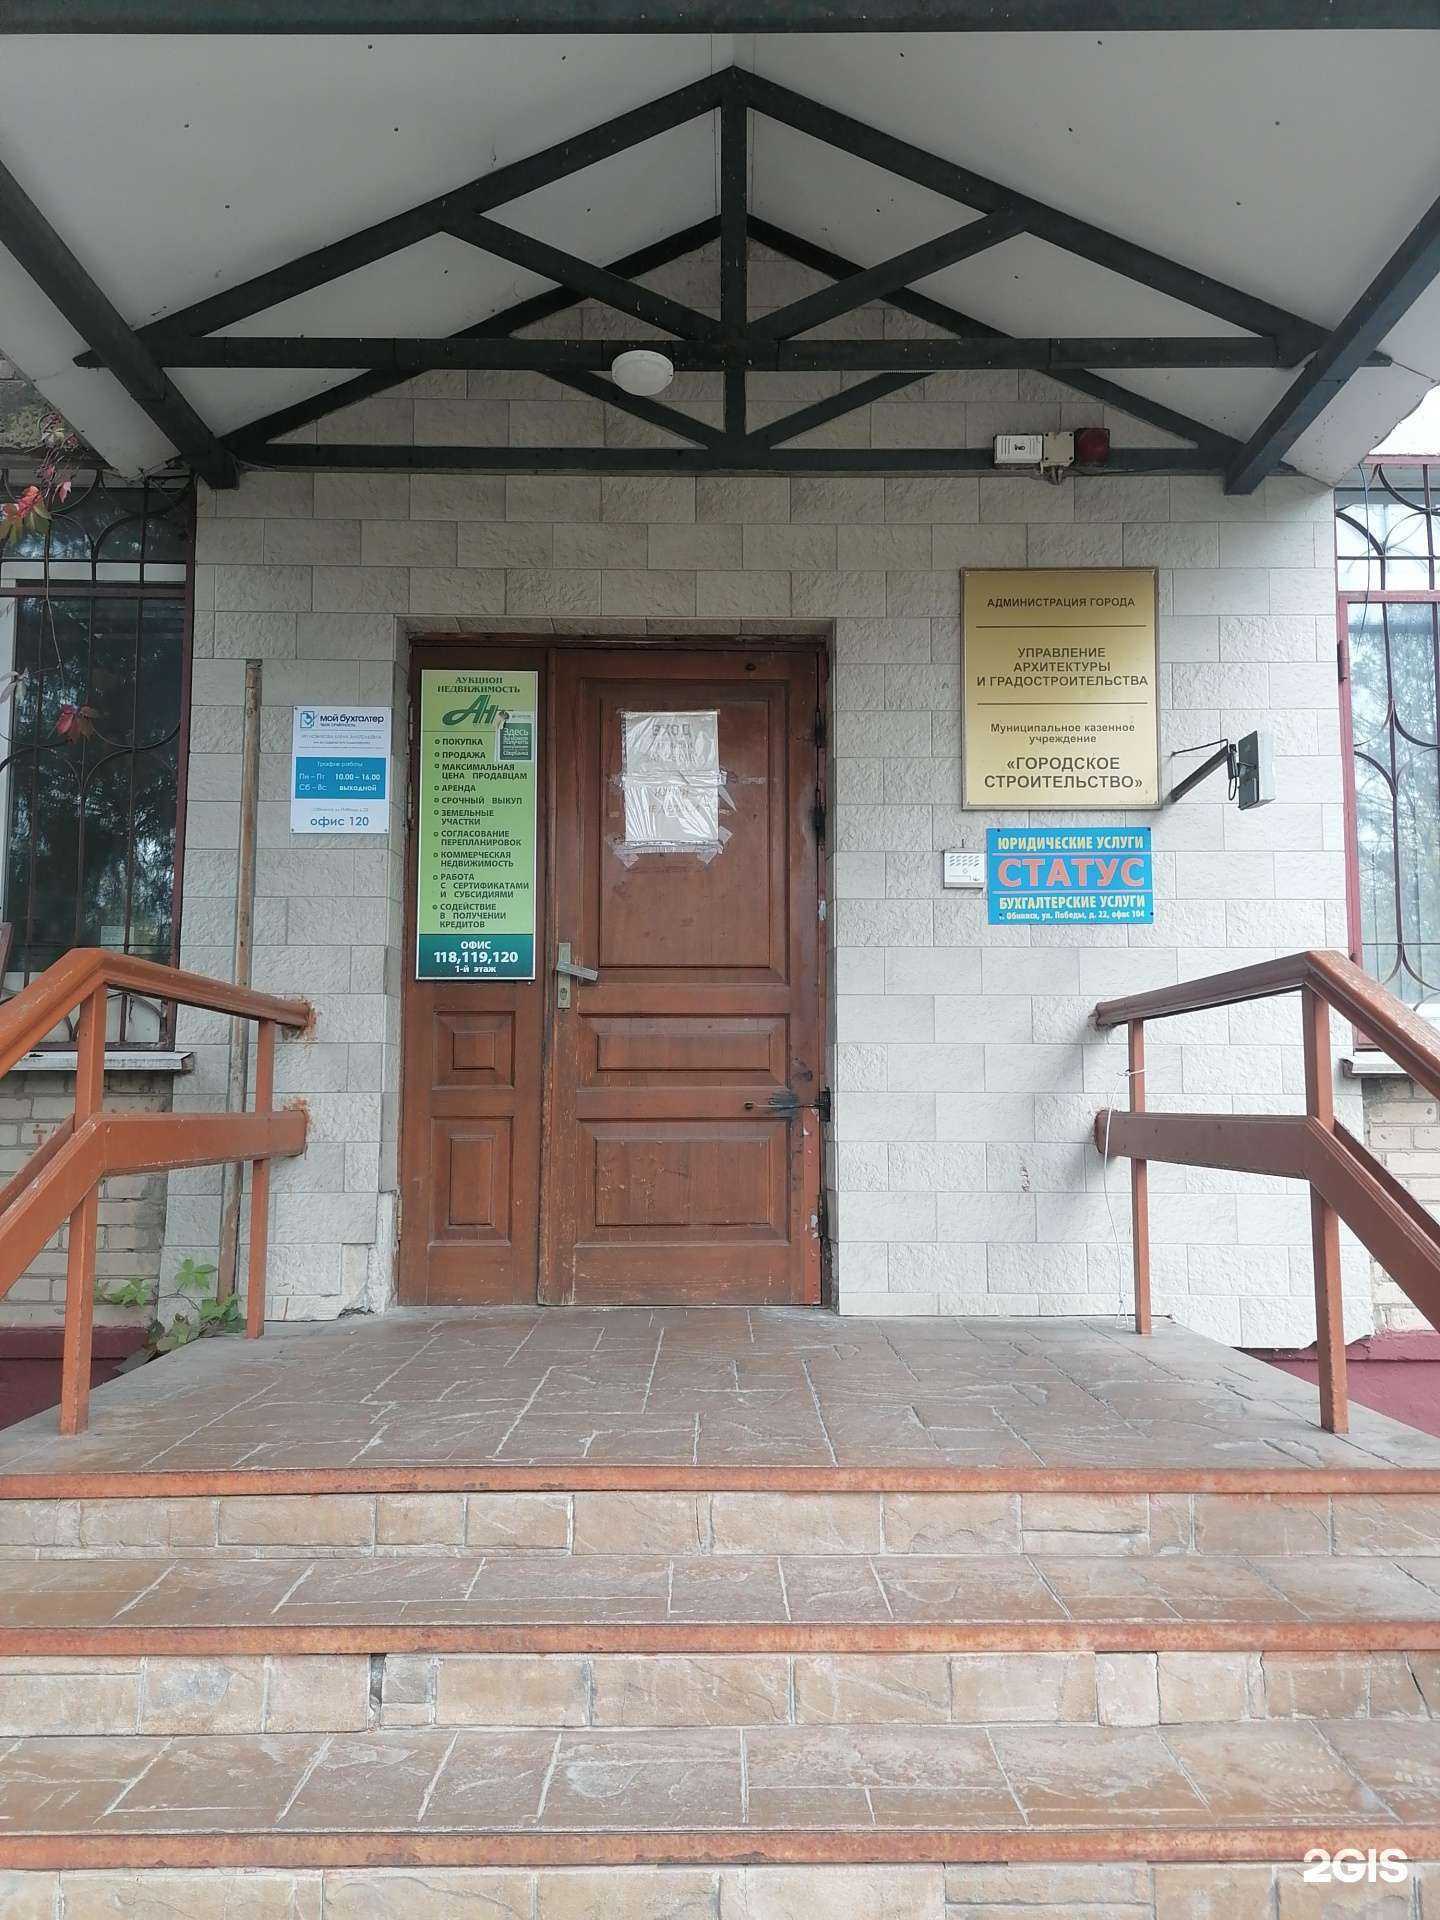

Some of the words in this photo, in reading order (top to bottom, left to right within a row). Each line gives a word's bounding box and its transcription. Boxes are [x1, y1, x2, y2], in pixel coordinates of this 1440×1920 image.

[987, 598, 1086, 609] АДМИНИСТРАЦИЯ
[1090, 598, 1135, 608] ГОРОДА
[1018, 648, 1106, 658] УПРАВЛЕНИЕ
[1014, 662, 1111, 672] АРХИТЕКТУРЫ
[977, 677, 986, 686] И
[990, 676, 1148, 688] ГРАДОСТРОИТЕЛЬСТВА
[438, 686, 520, 694] НЕДВИЖИМОСТЬ
[320, 714, 339, 722] мой
[340, 714, 384, 724] бухгалтер
[991, 724, 1080, 735] Муниципальное
[1084, 724, 1135, 732] казенное
[443, 738, 483, 746] ПОКУПКА
[1029, 736, 1096, 745] учреждение
[1007, 757, 1120, 772] «ГОРОДСКОЕ
[985, 775, 1142, 788] СТРОИТЕЛЬСТВО»
[339, 784, 376, 792] выходной
[442, 797, 484, 805] СРОЧНЫЙ
[311, 816, 345, 828] офис
[348, 817, 369, 826] 120
[998, 837, 1092, 851] ЮРИДИЧЕСКИЕ
[1097, 836, 1143, 849] УСЛУГИ
[441, 860, 514, 868] НЕДВИЖИМОСТЬ
[998, 858, 1145, 887] СТАТУС
[454, 891, 514, 899] СУБСИДИЯМИ
[440, 903, 496, 911] СОДЕЙСТВИЕ
[1000, 896, 1097, 910] БУХГАЛТЕРСКИЕ
[1100, 895, 1145, 908] УСЛУГИ
[440, 921, 485, 929] КРЕДИТОВ
[461, 941, 491, 950] ОФИС
[434, 951, 518, 964] 118,119,120
[455, 965, 469, 973] 1-й
